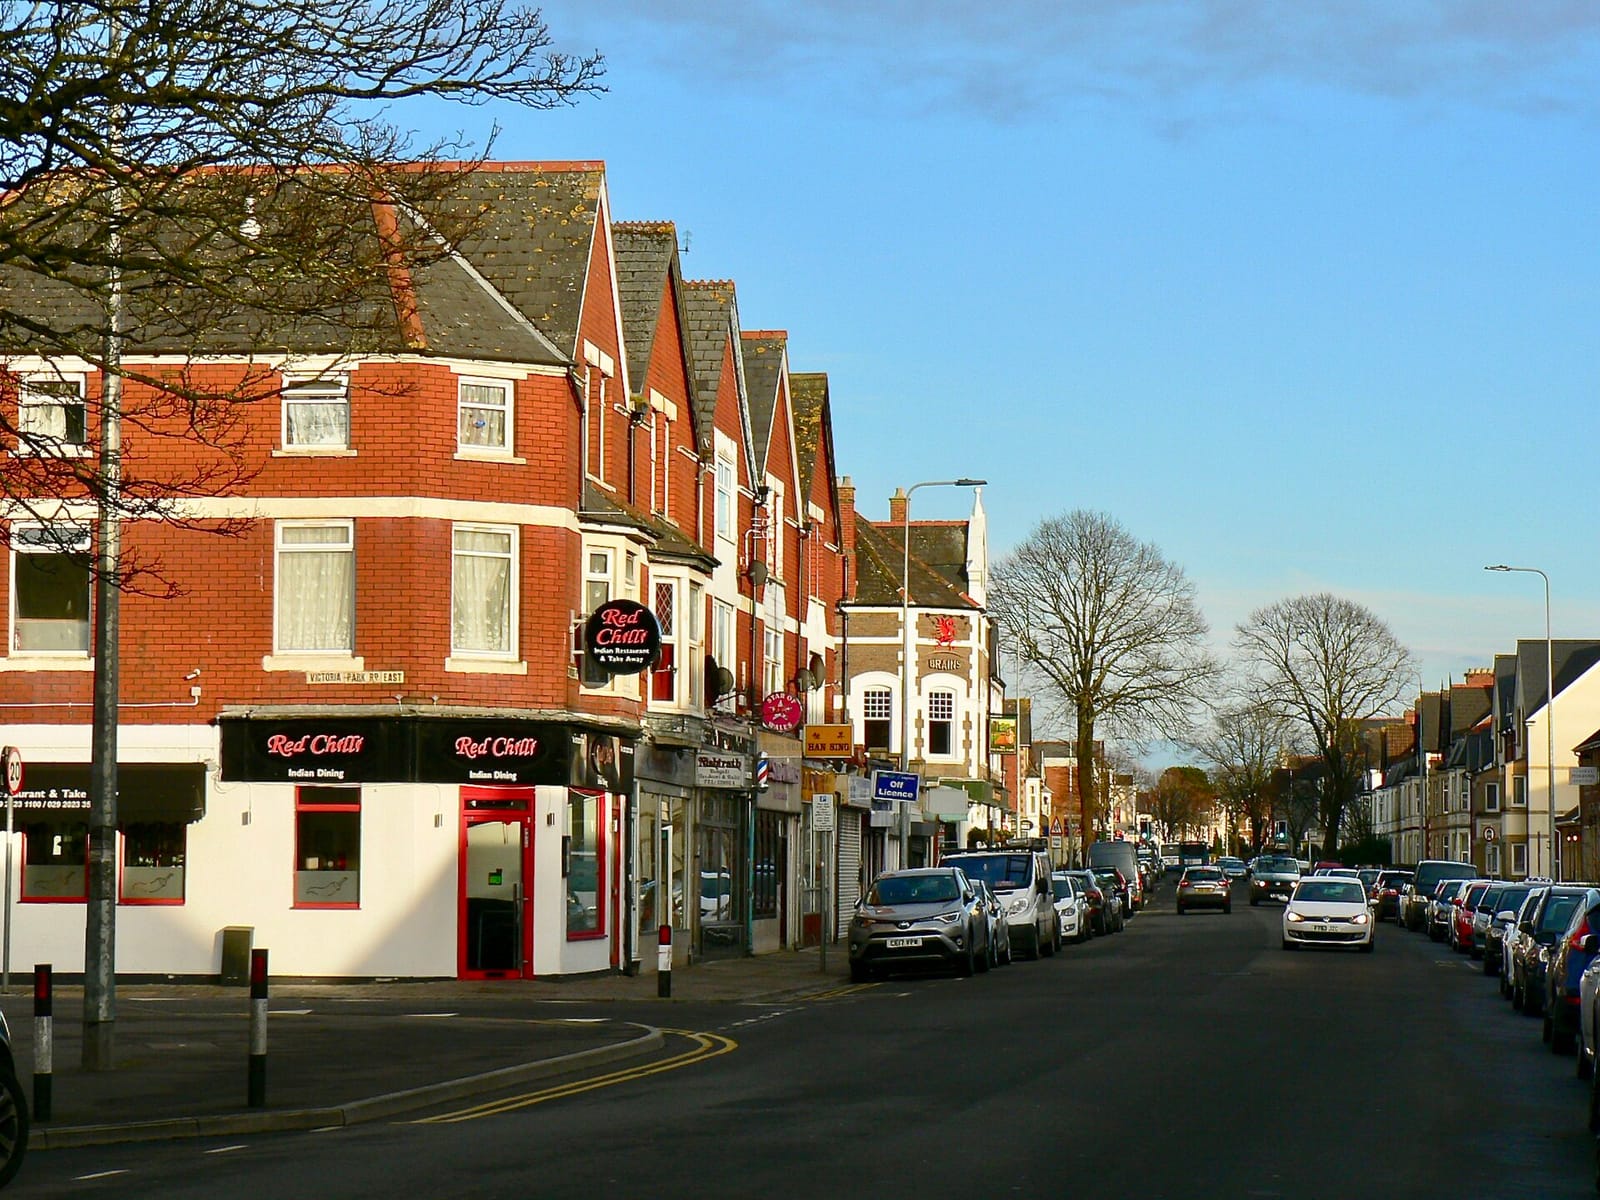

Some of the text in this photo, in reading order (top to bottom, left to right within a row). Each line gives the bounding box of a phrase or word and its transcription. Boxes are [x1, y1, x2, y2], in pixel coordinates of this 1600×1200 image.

[601, 608, 643, 627] Red
[596, 628, 648, 645] Chilli
[928, 658, 961, 671] BRAINS
[310, 672, 341, 682] VICTORIA
[346, 672, 366, 682] PARK
[383, 672, 402, 682] EAST
[767, 692, 785, 704] STAR
[768, 721, 793, 731] WALES
[267, 734, 364, 757] Red Chilli
[455, 736, 538, 759] Red Chilli
[808, 743, 826, 751] HAN
[829, 743, 849, 751] SING
[10, 761, 20, 781] 20
[288, 768, 344, 779] Indian Dining
[469, 769, 518, 782] Indian Dining
[889, 780, 904, 789] Off
[49, 789, 58, 798] &
[61, 789, 87, 798] Take
[878, 788, 914, 798] Licence
